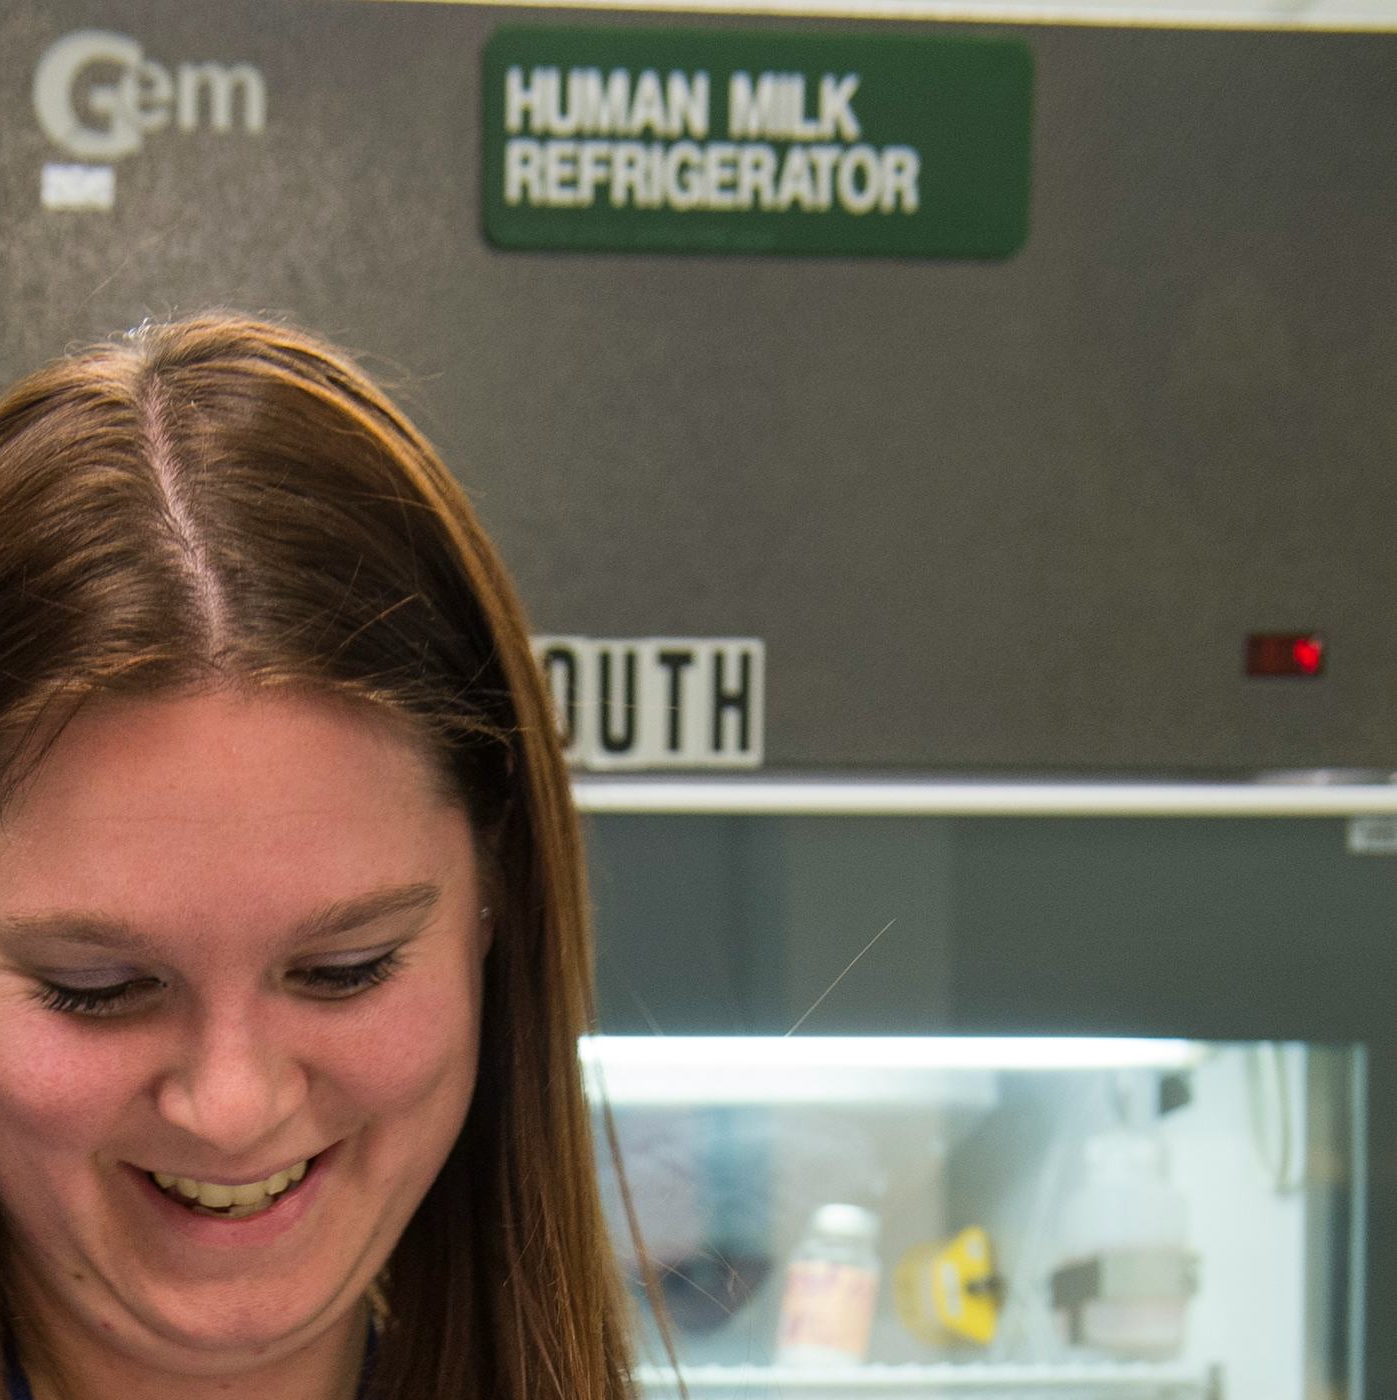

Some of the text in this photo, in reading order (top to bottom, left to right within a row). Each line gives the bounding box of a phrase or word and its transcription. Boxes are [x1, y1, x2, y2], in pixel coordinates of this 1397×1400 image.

[505, 67, 861, 140] HUMAN MILK
[504, 140, 920, 214] REFRIGERATOR
[545, 646, 751, 755] OUTH
